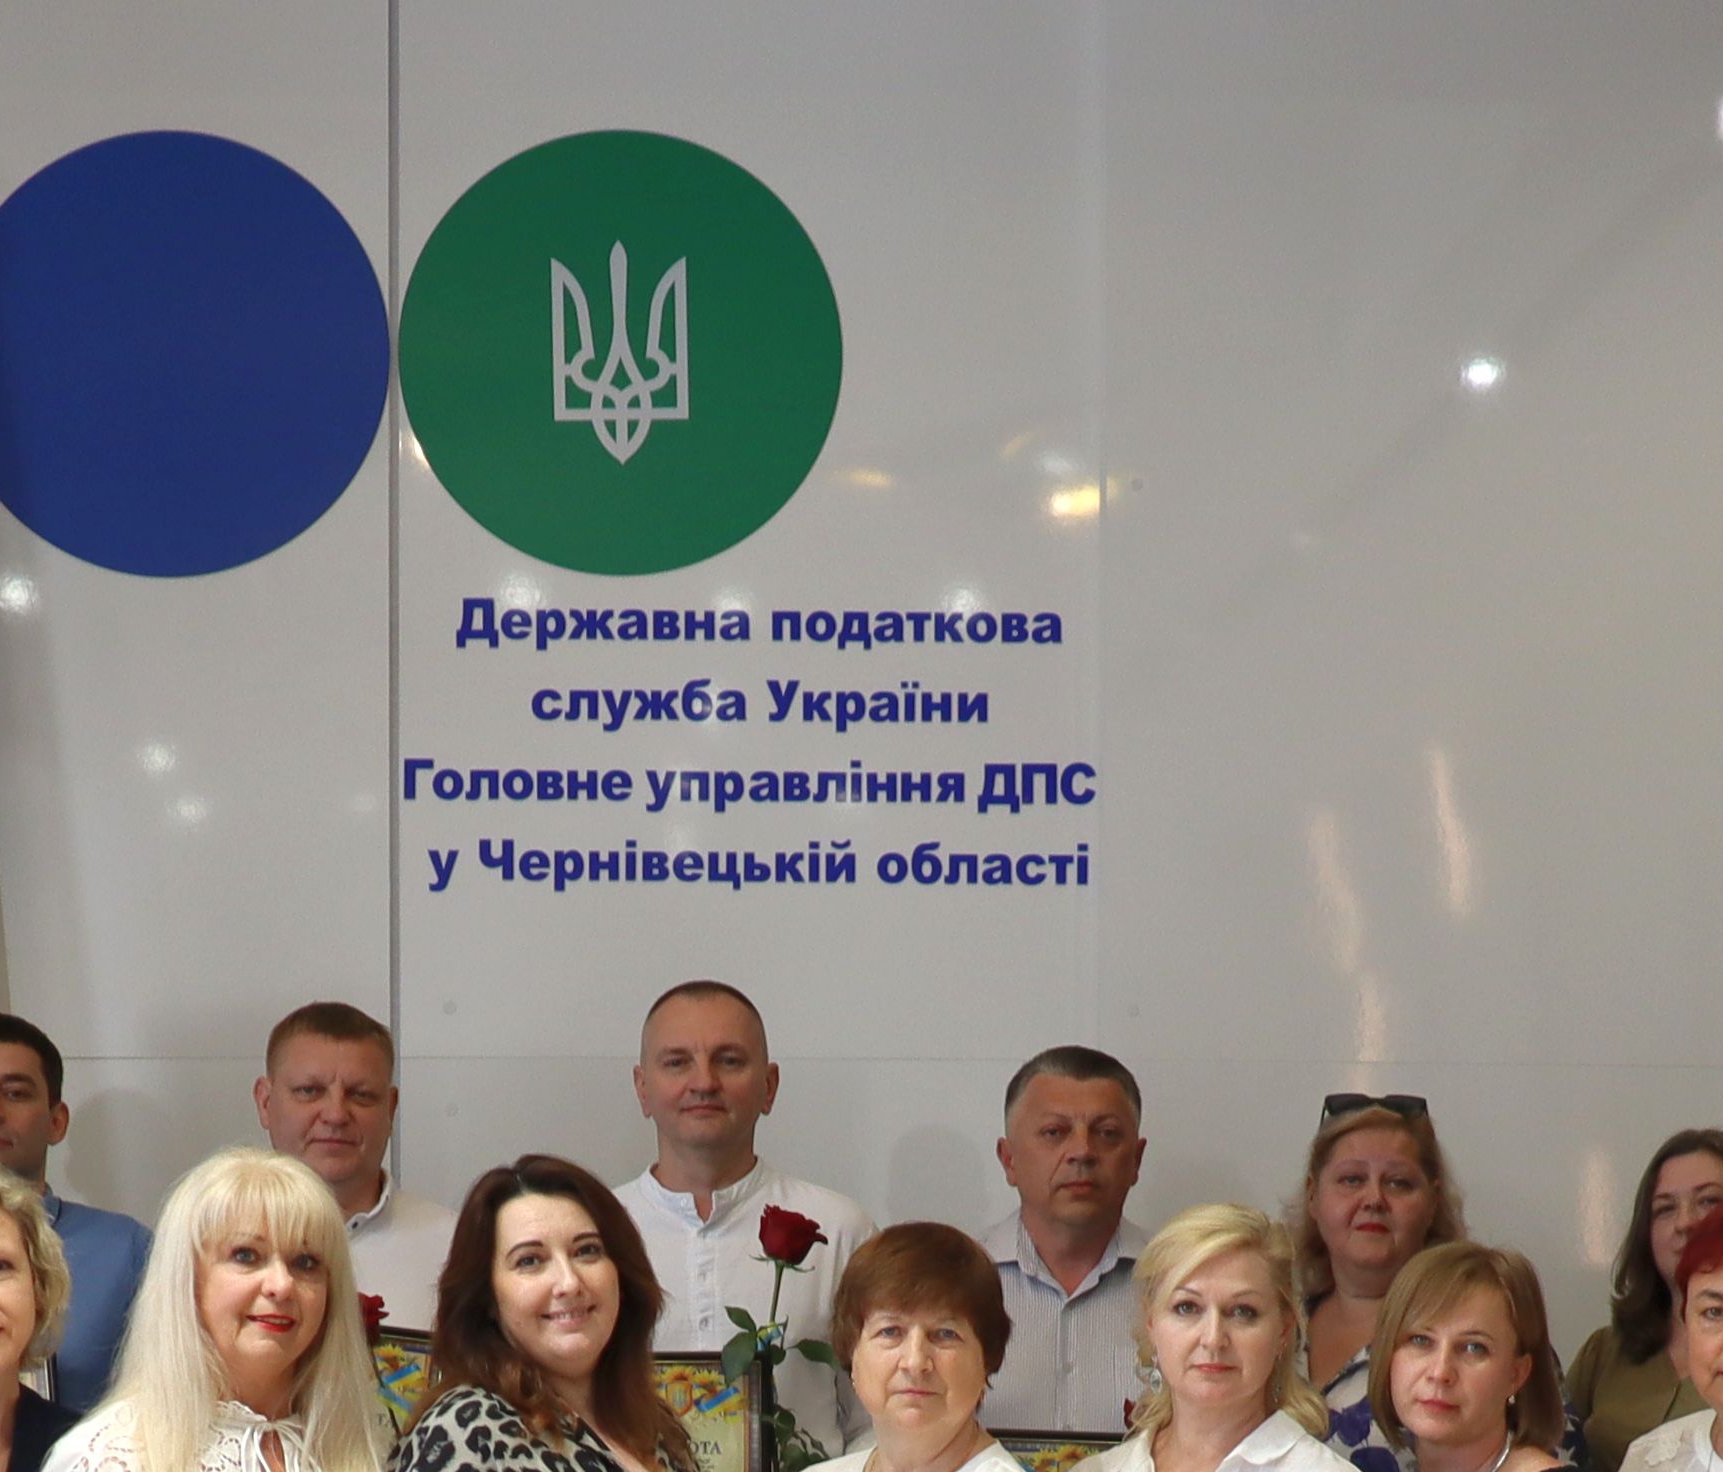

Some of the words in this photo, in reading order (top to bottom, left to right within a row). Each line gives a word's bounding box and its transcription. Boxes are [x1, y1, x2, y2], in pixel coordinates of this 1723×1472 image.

[456, 598, 750, 651] Державна
[772, 608, 1063, 649] податкова
[531, 679, 747, 732] служба
[768, 680, 989, 733] України
[403, 759, 633, 802] Головне
[645, 760, 966, 813] управління
[977, 763, 1097, 814] ДПС
[427, 850, 459, 893] у
[479, 839, 856, 893] Чернівецькій
[877, 842, 1090, 887] області
